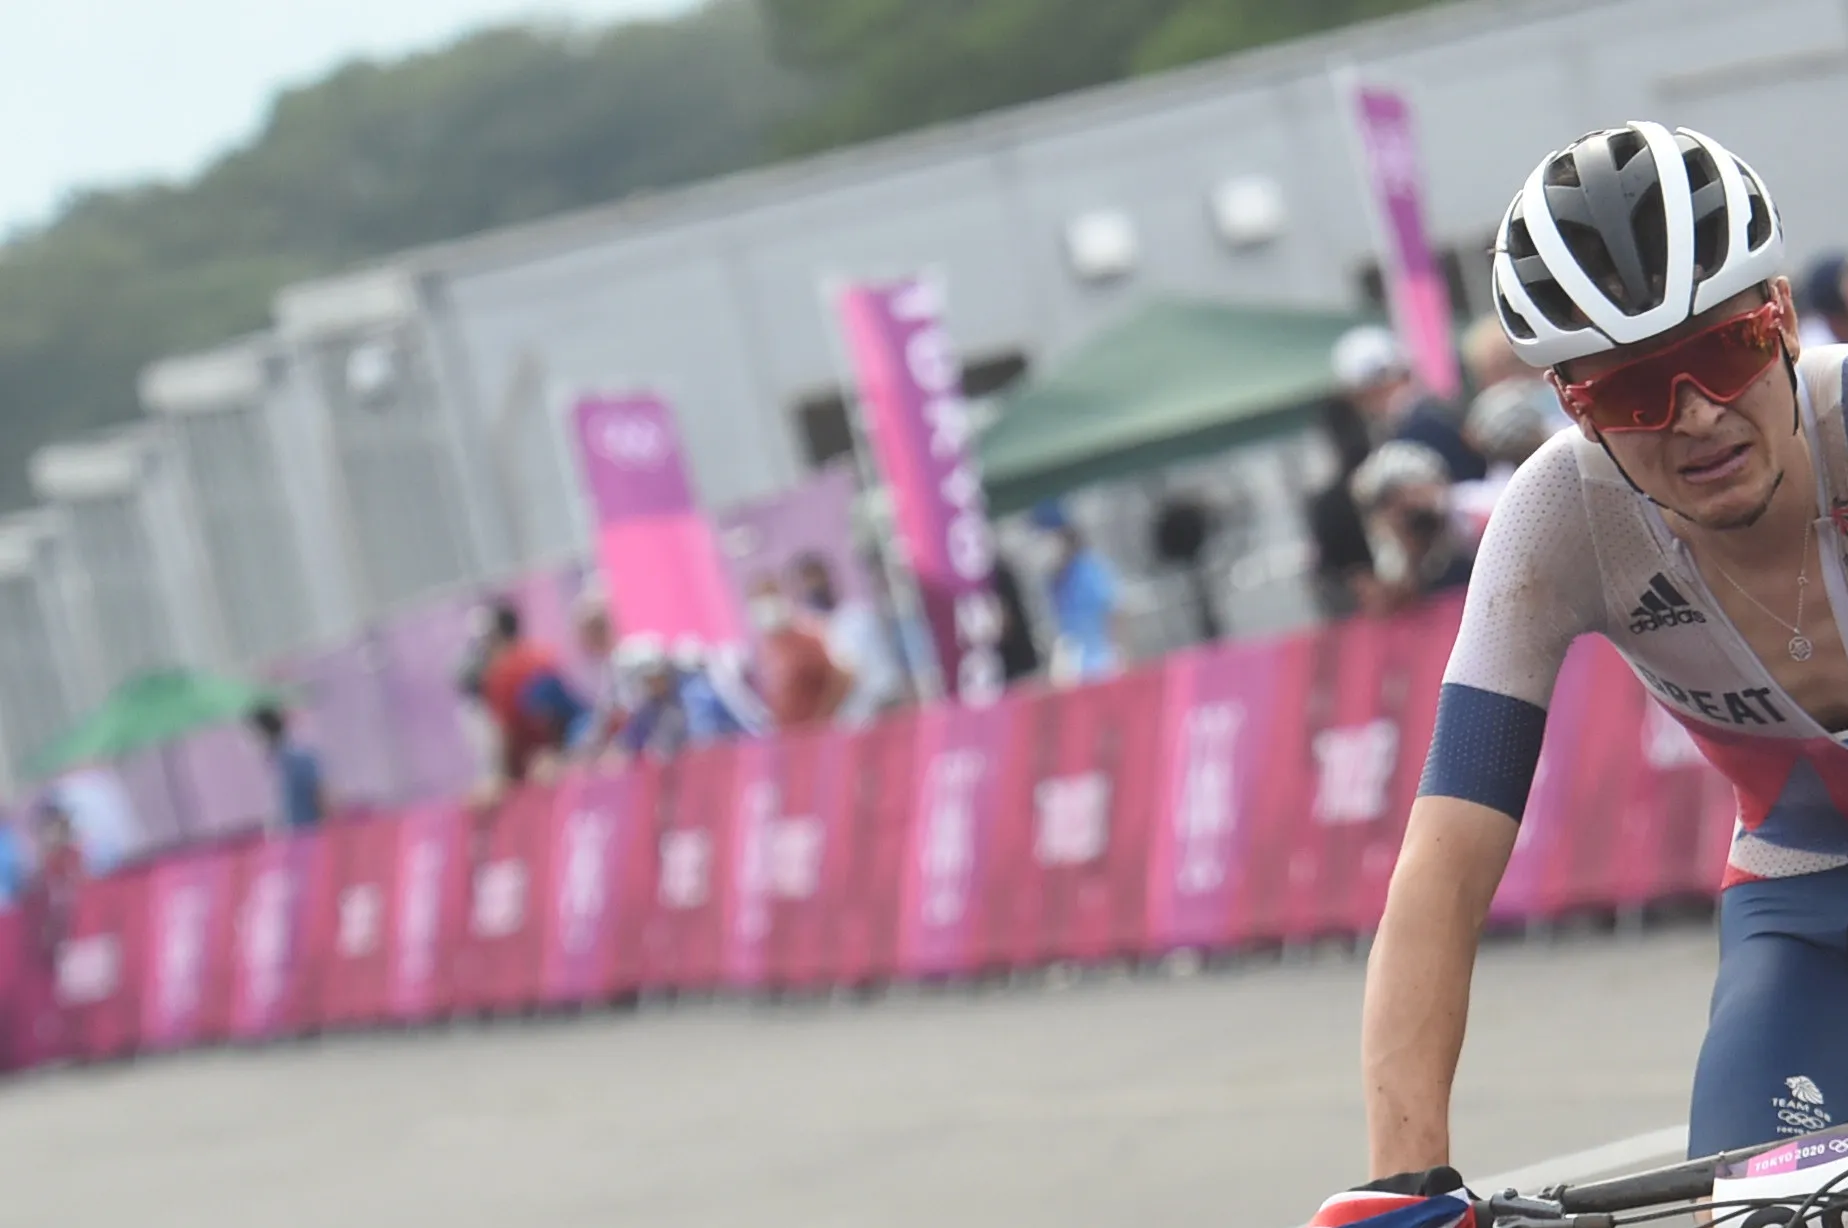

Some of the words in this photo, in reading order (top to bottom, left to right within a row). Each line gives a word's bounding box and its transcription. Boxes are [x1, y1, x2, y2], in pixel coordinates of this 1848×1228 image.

[1630, 606, 1706, 635] adidas
[1634, 662, 1787, 725] GREAT
[1772, 1097, 1809, 1112] TEAM
[1776, 1126, 1804, 1136] TOKYO
[1754, 1152, 1794, 1173] TOKYO
[1795, 1142, 1826, 1159] 2020
